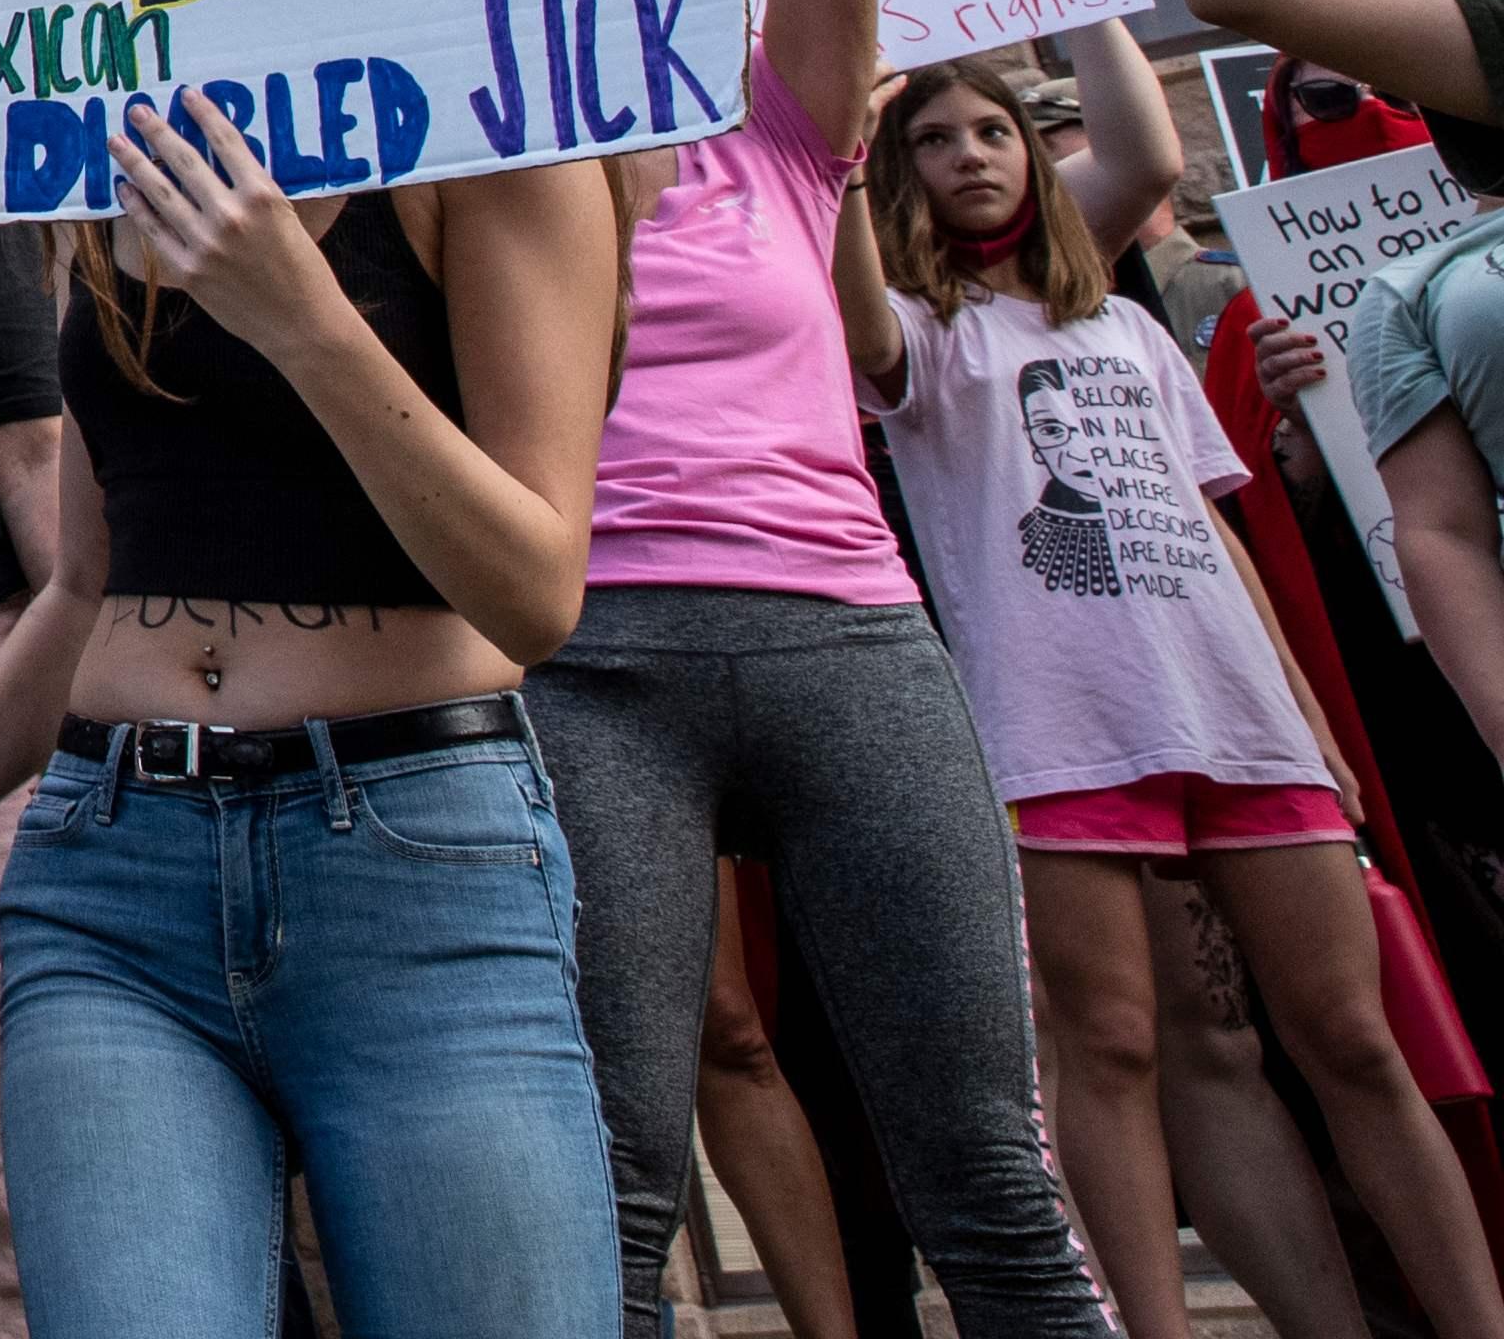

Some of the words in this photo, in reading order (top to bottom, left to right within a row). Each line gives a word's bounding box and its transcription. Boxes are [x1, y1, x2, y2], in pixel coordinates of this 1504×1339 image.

[1267, 200, 1362, 243] How
[1371, 183, 1422, 220] to
[1309, 243, 1365, 274] an
[1064, 356, 1142, 377] WOMEN
[1071, 385, 1153, 409] BELONG
[1080, 417, 1105, 438] IN
[1115, 417, 1160, 441] ALL
[1090, 446, 1169, 474] PLACES
[1099, 477, 1180, 507] WHERE
[1107, 508, 1210, 543] DECISIONS
[1119, 540, 1160, 563] ARE
[1164, 543, 1218, 574] BEING
[1126, 574, 1190, 600] MADE
